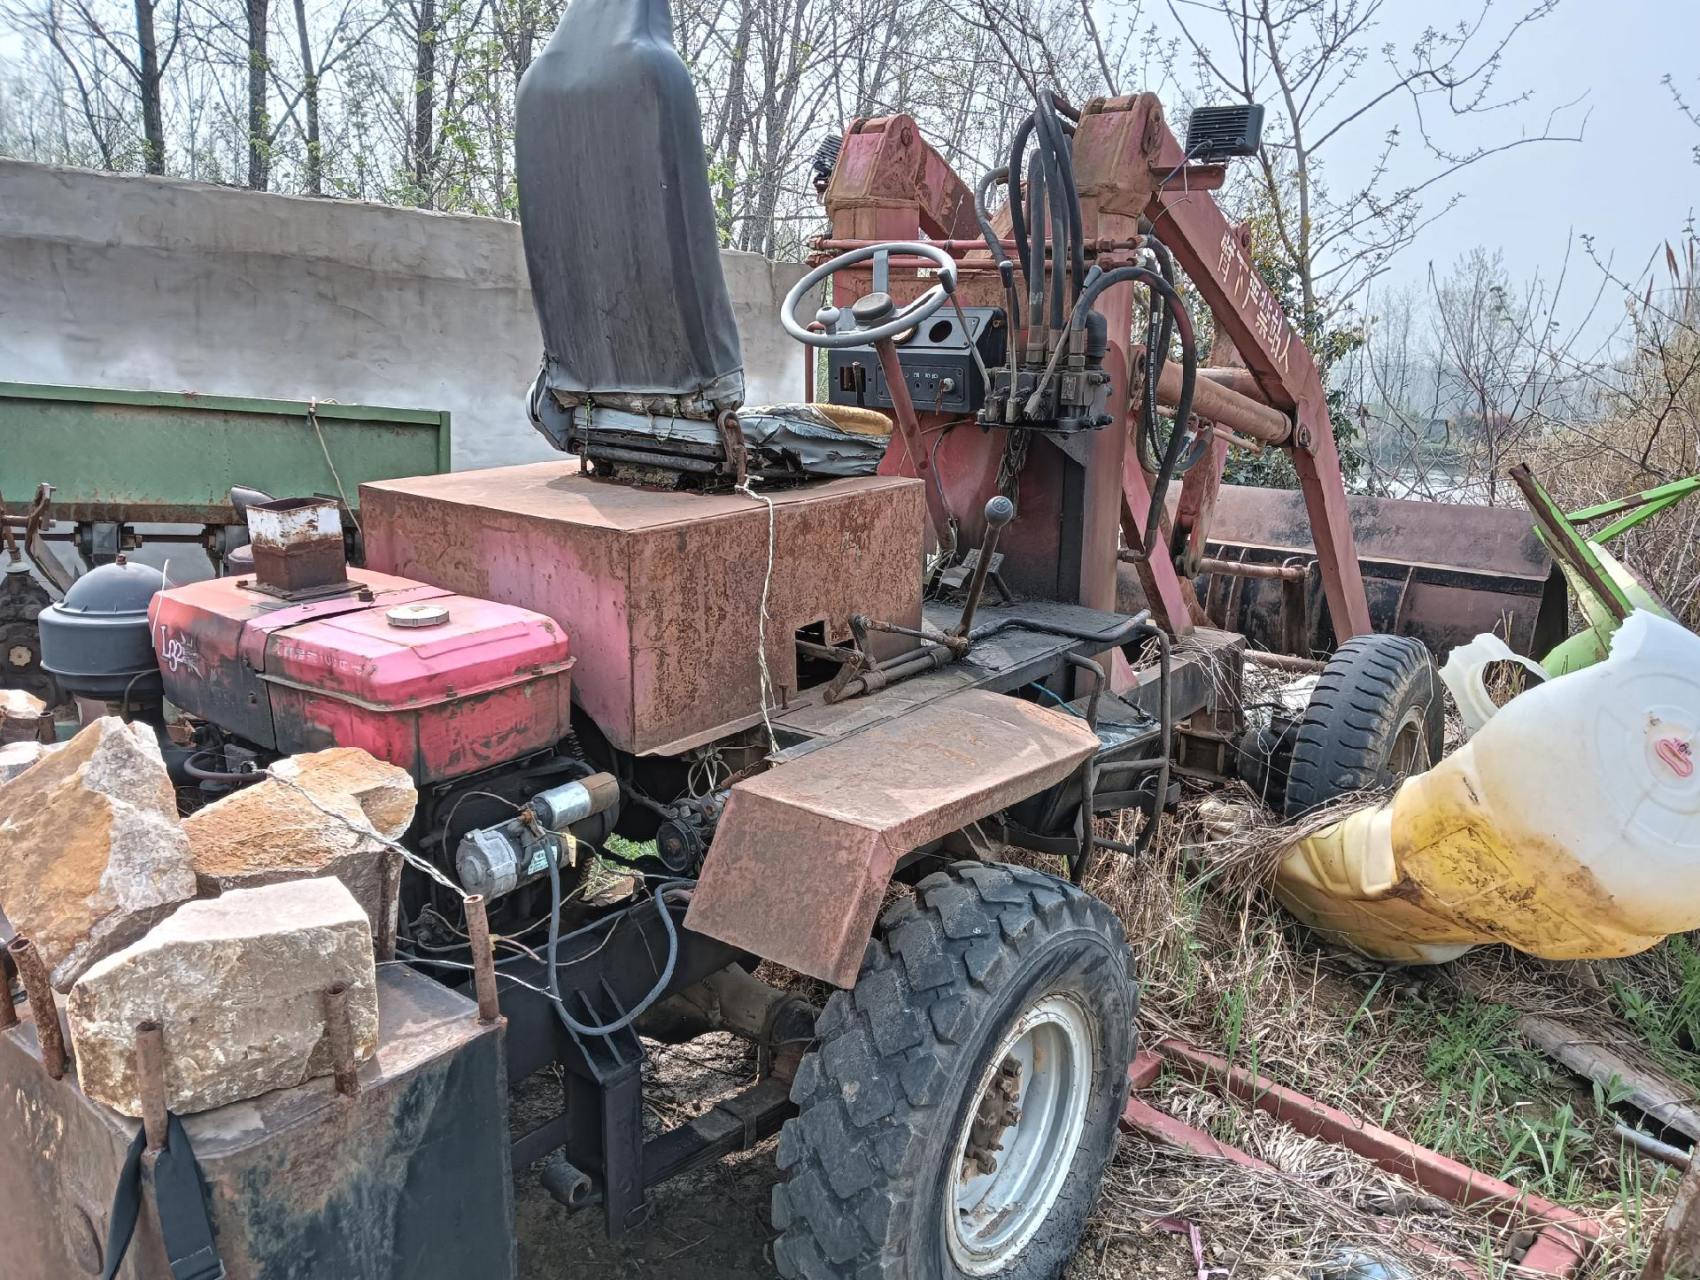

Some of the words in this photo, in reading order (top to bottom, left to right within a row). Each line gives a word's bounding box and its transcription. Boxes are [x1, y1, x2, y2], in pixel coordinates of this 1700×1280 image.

[1218, 229, 1291, 374] 臂下严禁站人
